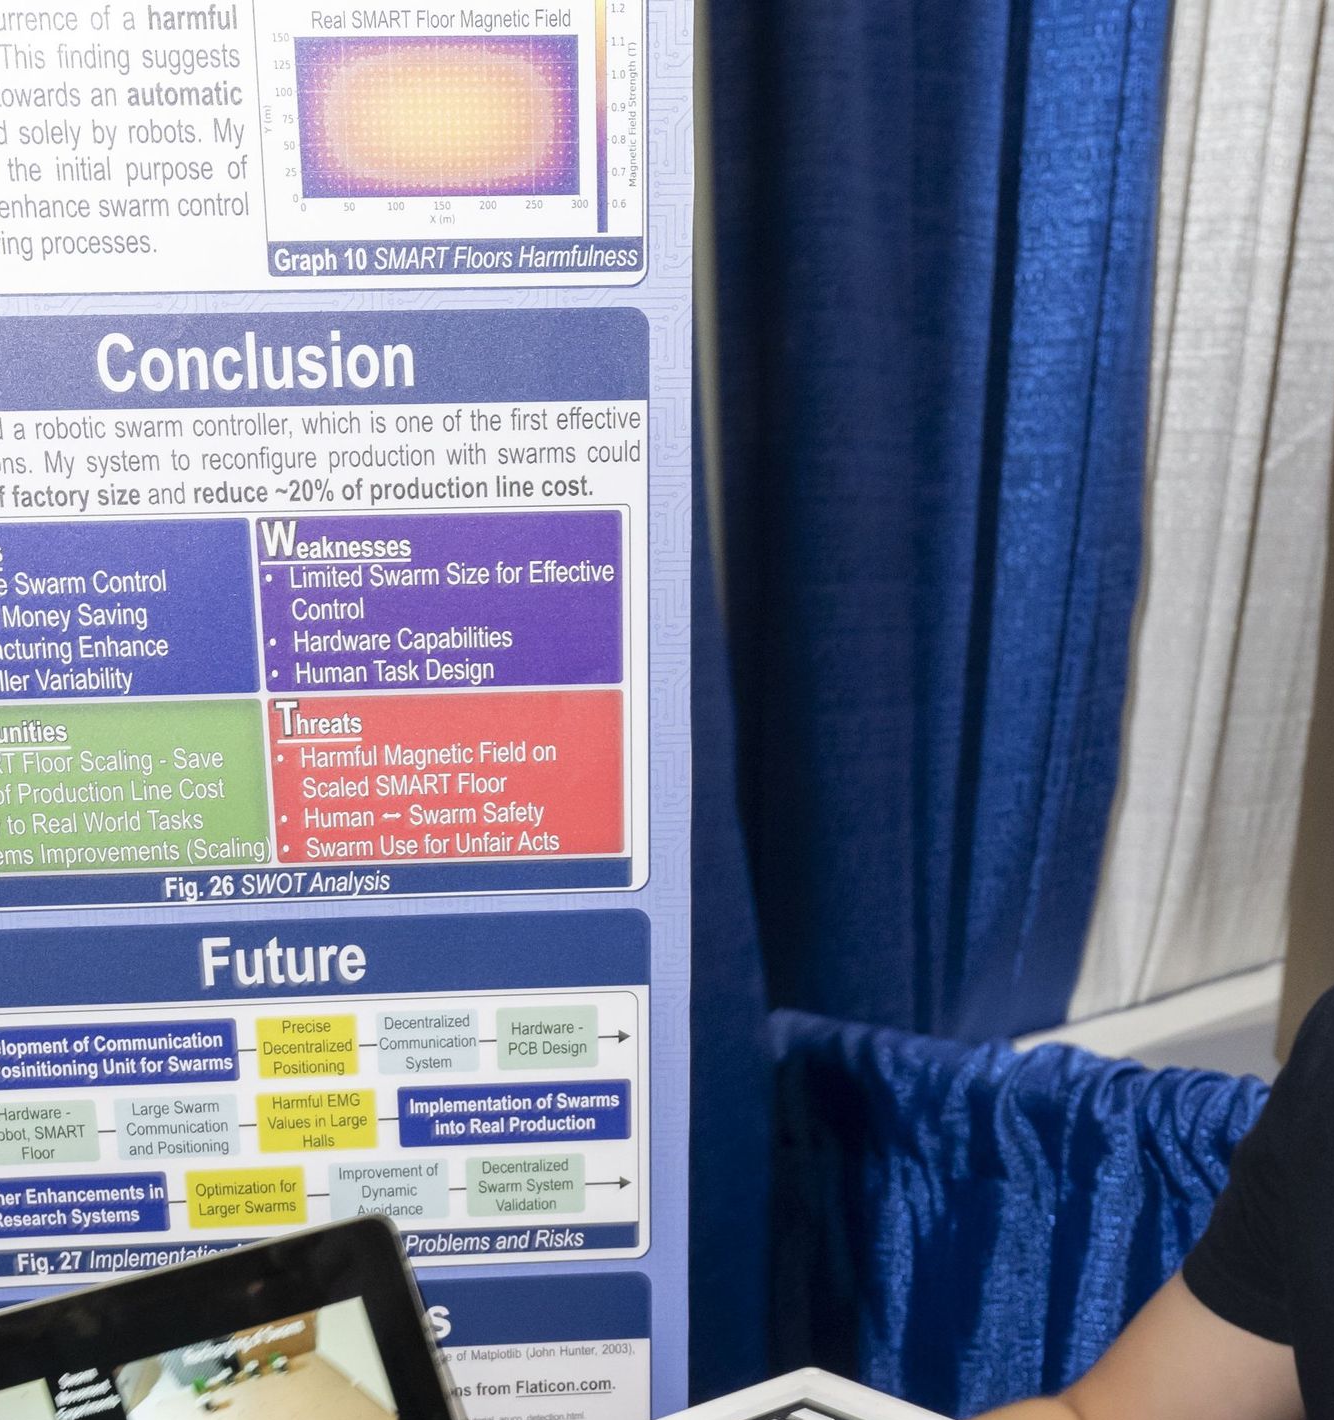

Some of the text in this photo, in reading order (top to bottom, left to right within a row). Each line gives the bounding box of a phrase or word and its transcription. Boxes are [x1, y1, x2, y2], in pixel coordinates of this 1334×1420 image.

[311, 9, 571, 32] Real SMART Floor Magnetic Field
[57, 43, 130, 75] finding
[142, 45, 240, 74] suggests
[274, 245, 638, 276] Graph 10 SMART Floors Harmfulness
[96, 331, 415, 393] Conclusion
[12, 485, 89, 512] factory
[98, 484, 140, 505] size
[148, 483, 186, 504] and
[193, 481, 267, 503] reduce
[275, 478, 333, 502] ~20%
[342, 478, 363, 500] of
[370, 476, 489, 505] production
[496, 475, 534, 497] line
[542, 476, 593, 496] cost.
[260, 520, 411, 558] Weaknesses
[14, 572, 86, 595] Swarm
[92, 569, 166, 592] Control
[296, 658, 494, 684] Human Task Design
[276, 701, 362, 736] Threats
[165, 870, 390, 901] Fig. 26 SWOT Analysis
[201, 937, 366, 987] Future
[73, 1035, 90, 1052] of
[94, 1032, 223, 1055] Communication
[103, 1056, 136, 1075] Unit
[140, 1055, 165, 1072] for
[168, 1053, 233, 1072] Swarms
[132, 1100, 220, 1119] Large Swarm
[272, 1092, 360, 1110] Harmful EMG
[410, 1091, 619, 1117] Implementation of Swarms
[435, 1115, 596, 1136] into Real Production
[195, 1179, 296, 1199] Optimization for
[406, 1228, 584, 1253] Problems and Risks
[477, 1382, 510, 1395] from
[516, 1378, 615, 1394] Flaticon.com.
